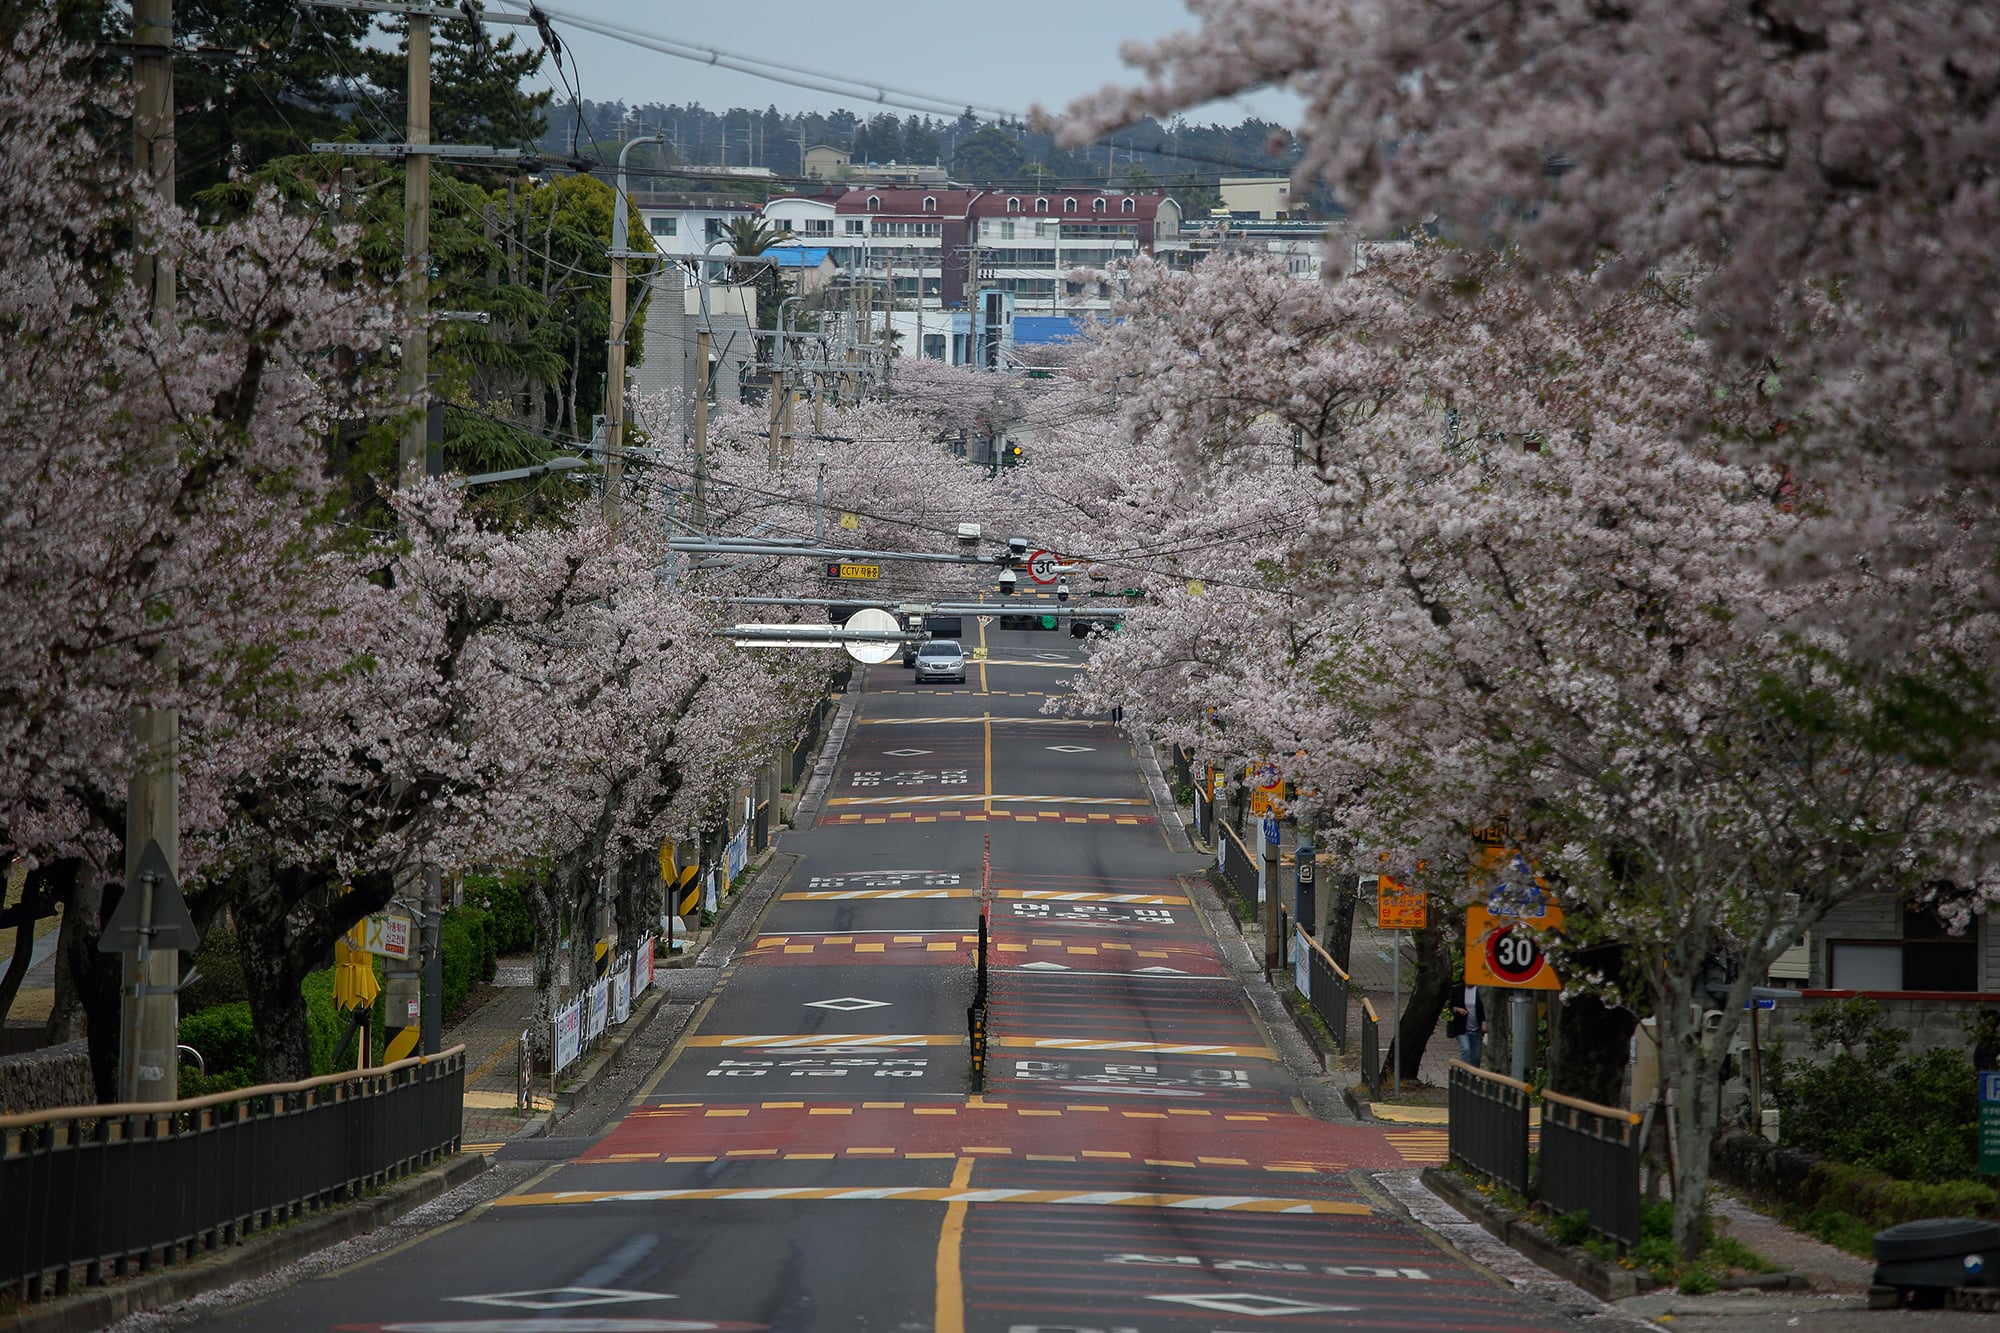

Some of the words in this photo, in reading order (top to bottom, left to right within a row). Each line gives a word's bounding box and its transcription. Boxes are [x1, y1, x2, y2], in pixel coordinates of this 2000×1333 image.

[841, 566, 860, 576] CCTV
[860, 567, 878, 578] 작동중
[1035, 560, 1056, 575] 30
[808, 879, 960, 888] 어린이
[810, 873, 961, 882] 보호구역
[1012, 903, 1171, 918] 어린이
[1014, 910, 1176, 925] 보호구역
[1499, 937, 1532, 966] 30
[718, 1058, 929, 1067] 보호구역
[706, 1068, 924, 1077] 어린이
[1015, 1060, 1250, 1081] 어린이
[1014, 1070, 1252, 1089] 보호구역
